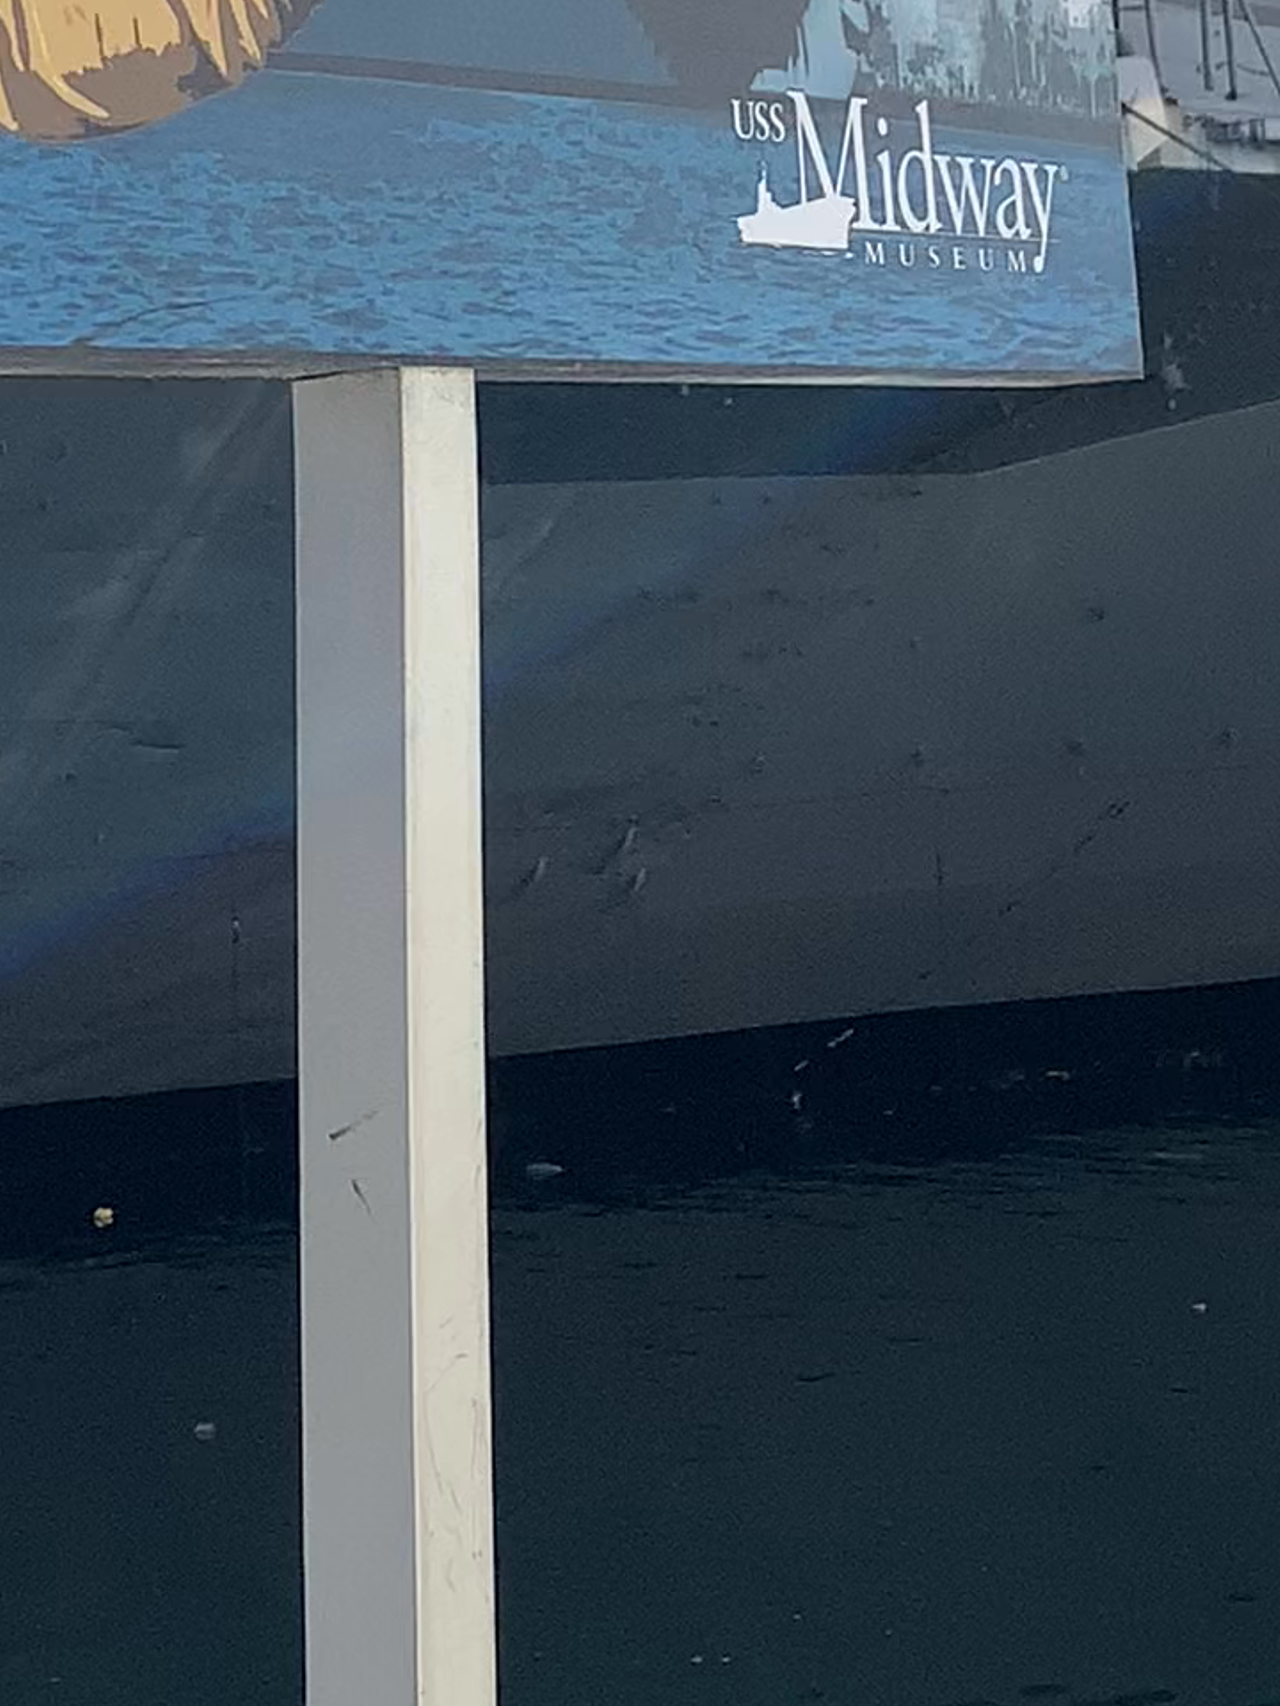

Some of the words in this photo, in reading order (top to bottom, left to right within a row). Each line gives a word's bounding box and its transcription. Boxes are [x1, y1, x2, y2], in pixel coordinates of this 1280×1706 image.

[730, 98, 786, 143] USS
[786, 90, 1058, 274] Midway
[864, 241, 1027, 274] MUSEUM
